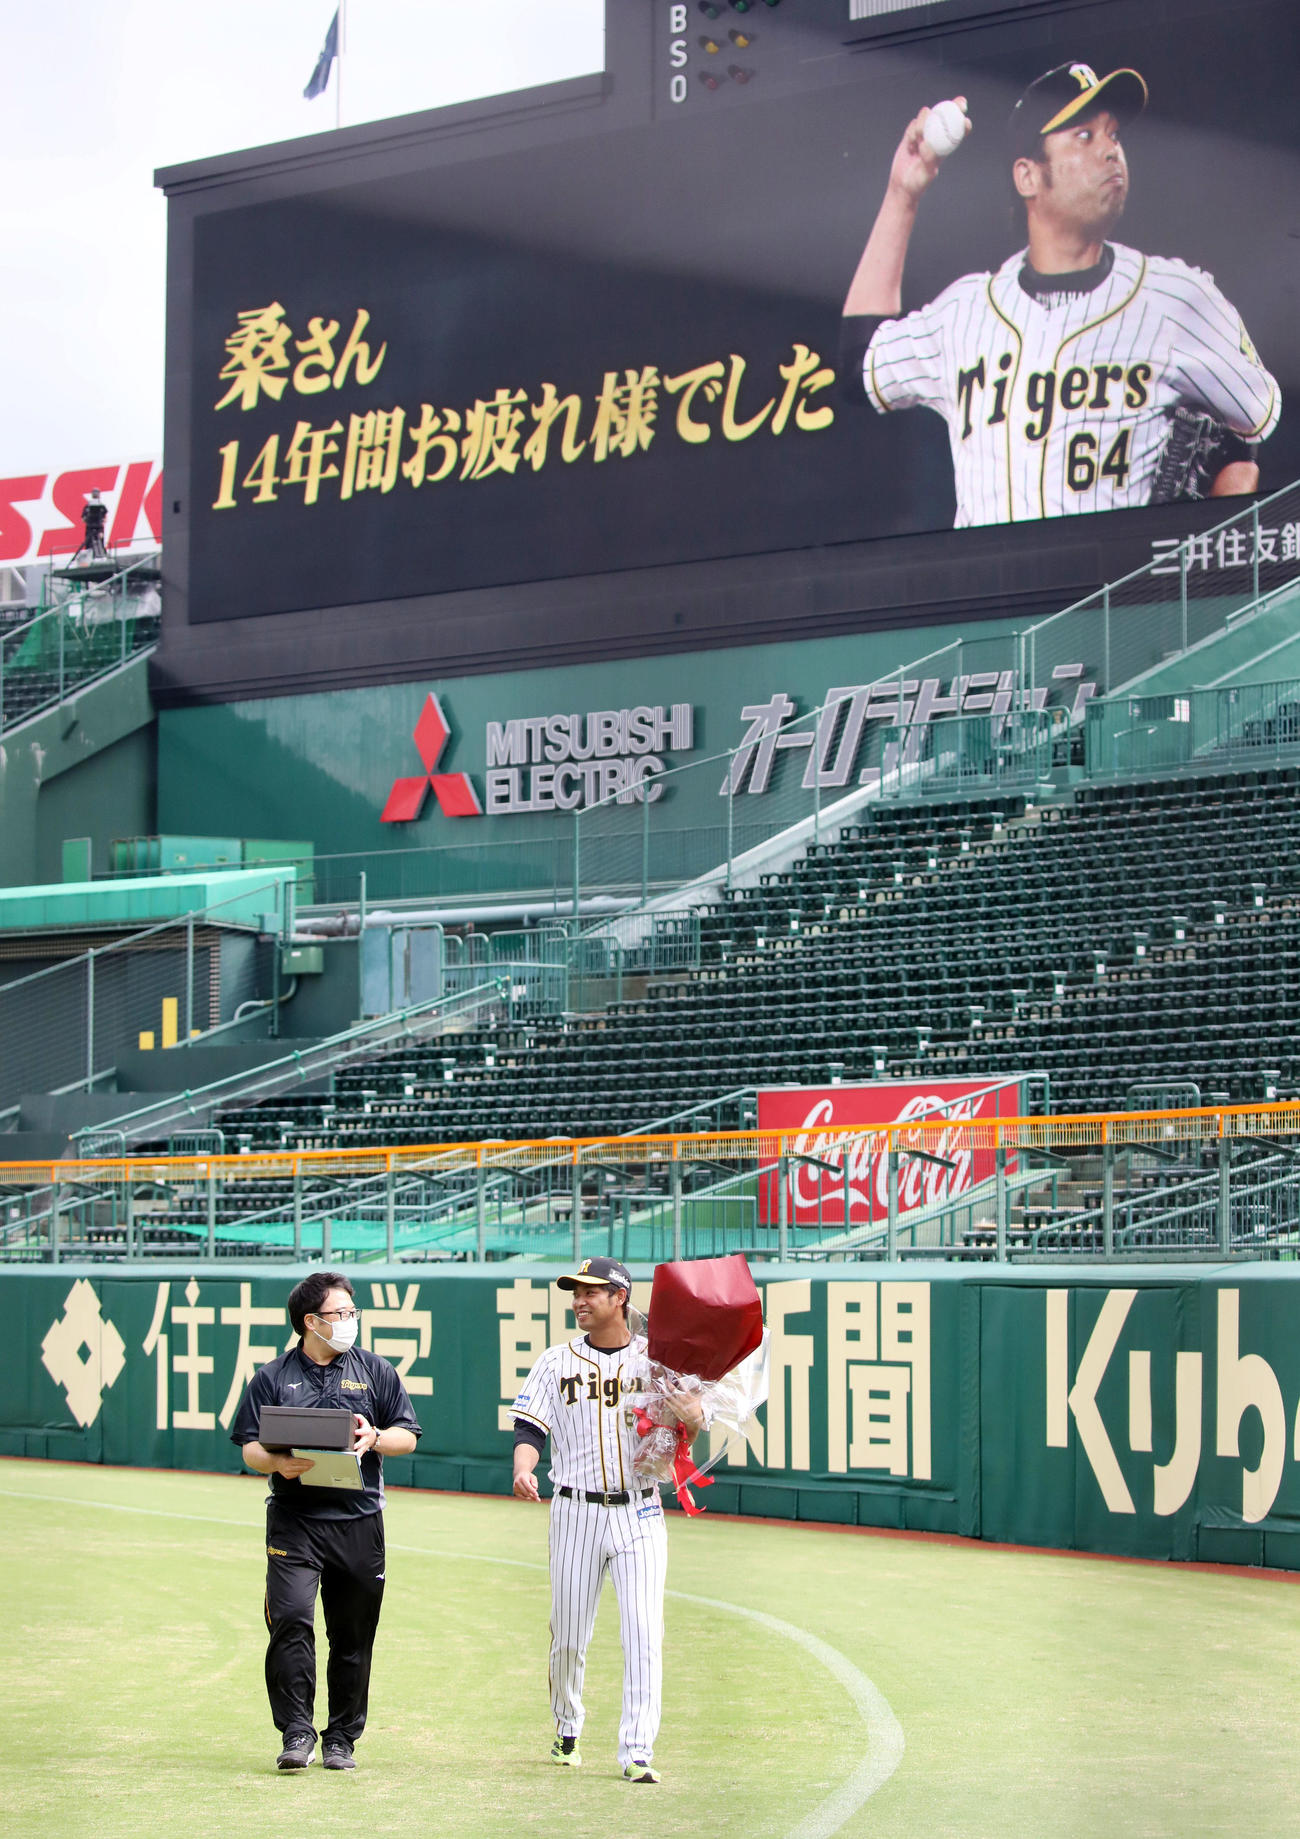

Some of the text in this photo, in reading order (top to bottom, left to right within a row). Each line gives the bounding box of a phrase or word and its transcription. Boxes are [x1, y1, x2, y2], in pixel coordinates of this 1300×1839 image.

[670, 4, 687, 33] B
[670, 40, 687, 67] S
[670, 75, 687, 103] O
[214, 301, 387, 411] 桑さん
[212, 344, 836, 510] 14年間お疲れ様でした
[957, 352, 1152, 441] Tigers
[1066, 428, 1131, 493] 64
[486, 703, 694, 767] MITSUBISHI
[486, 756, 666, 815] ELECTRIC
[142, 1276, 434, 1430] 住友学
[1046, 1288, 1300, 1523] Kub
